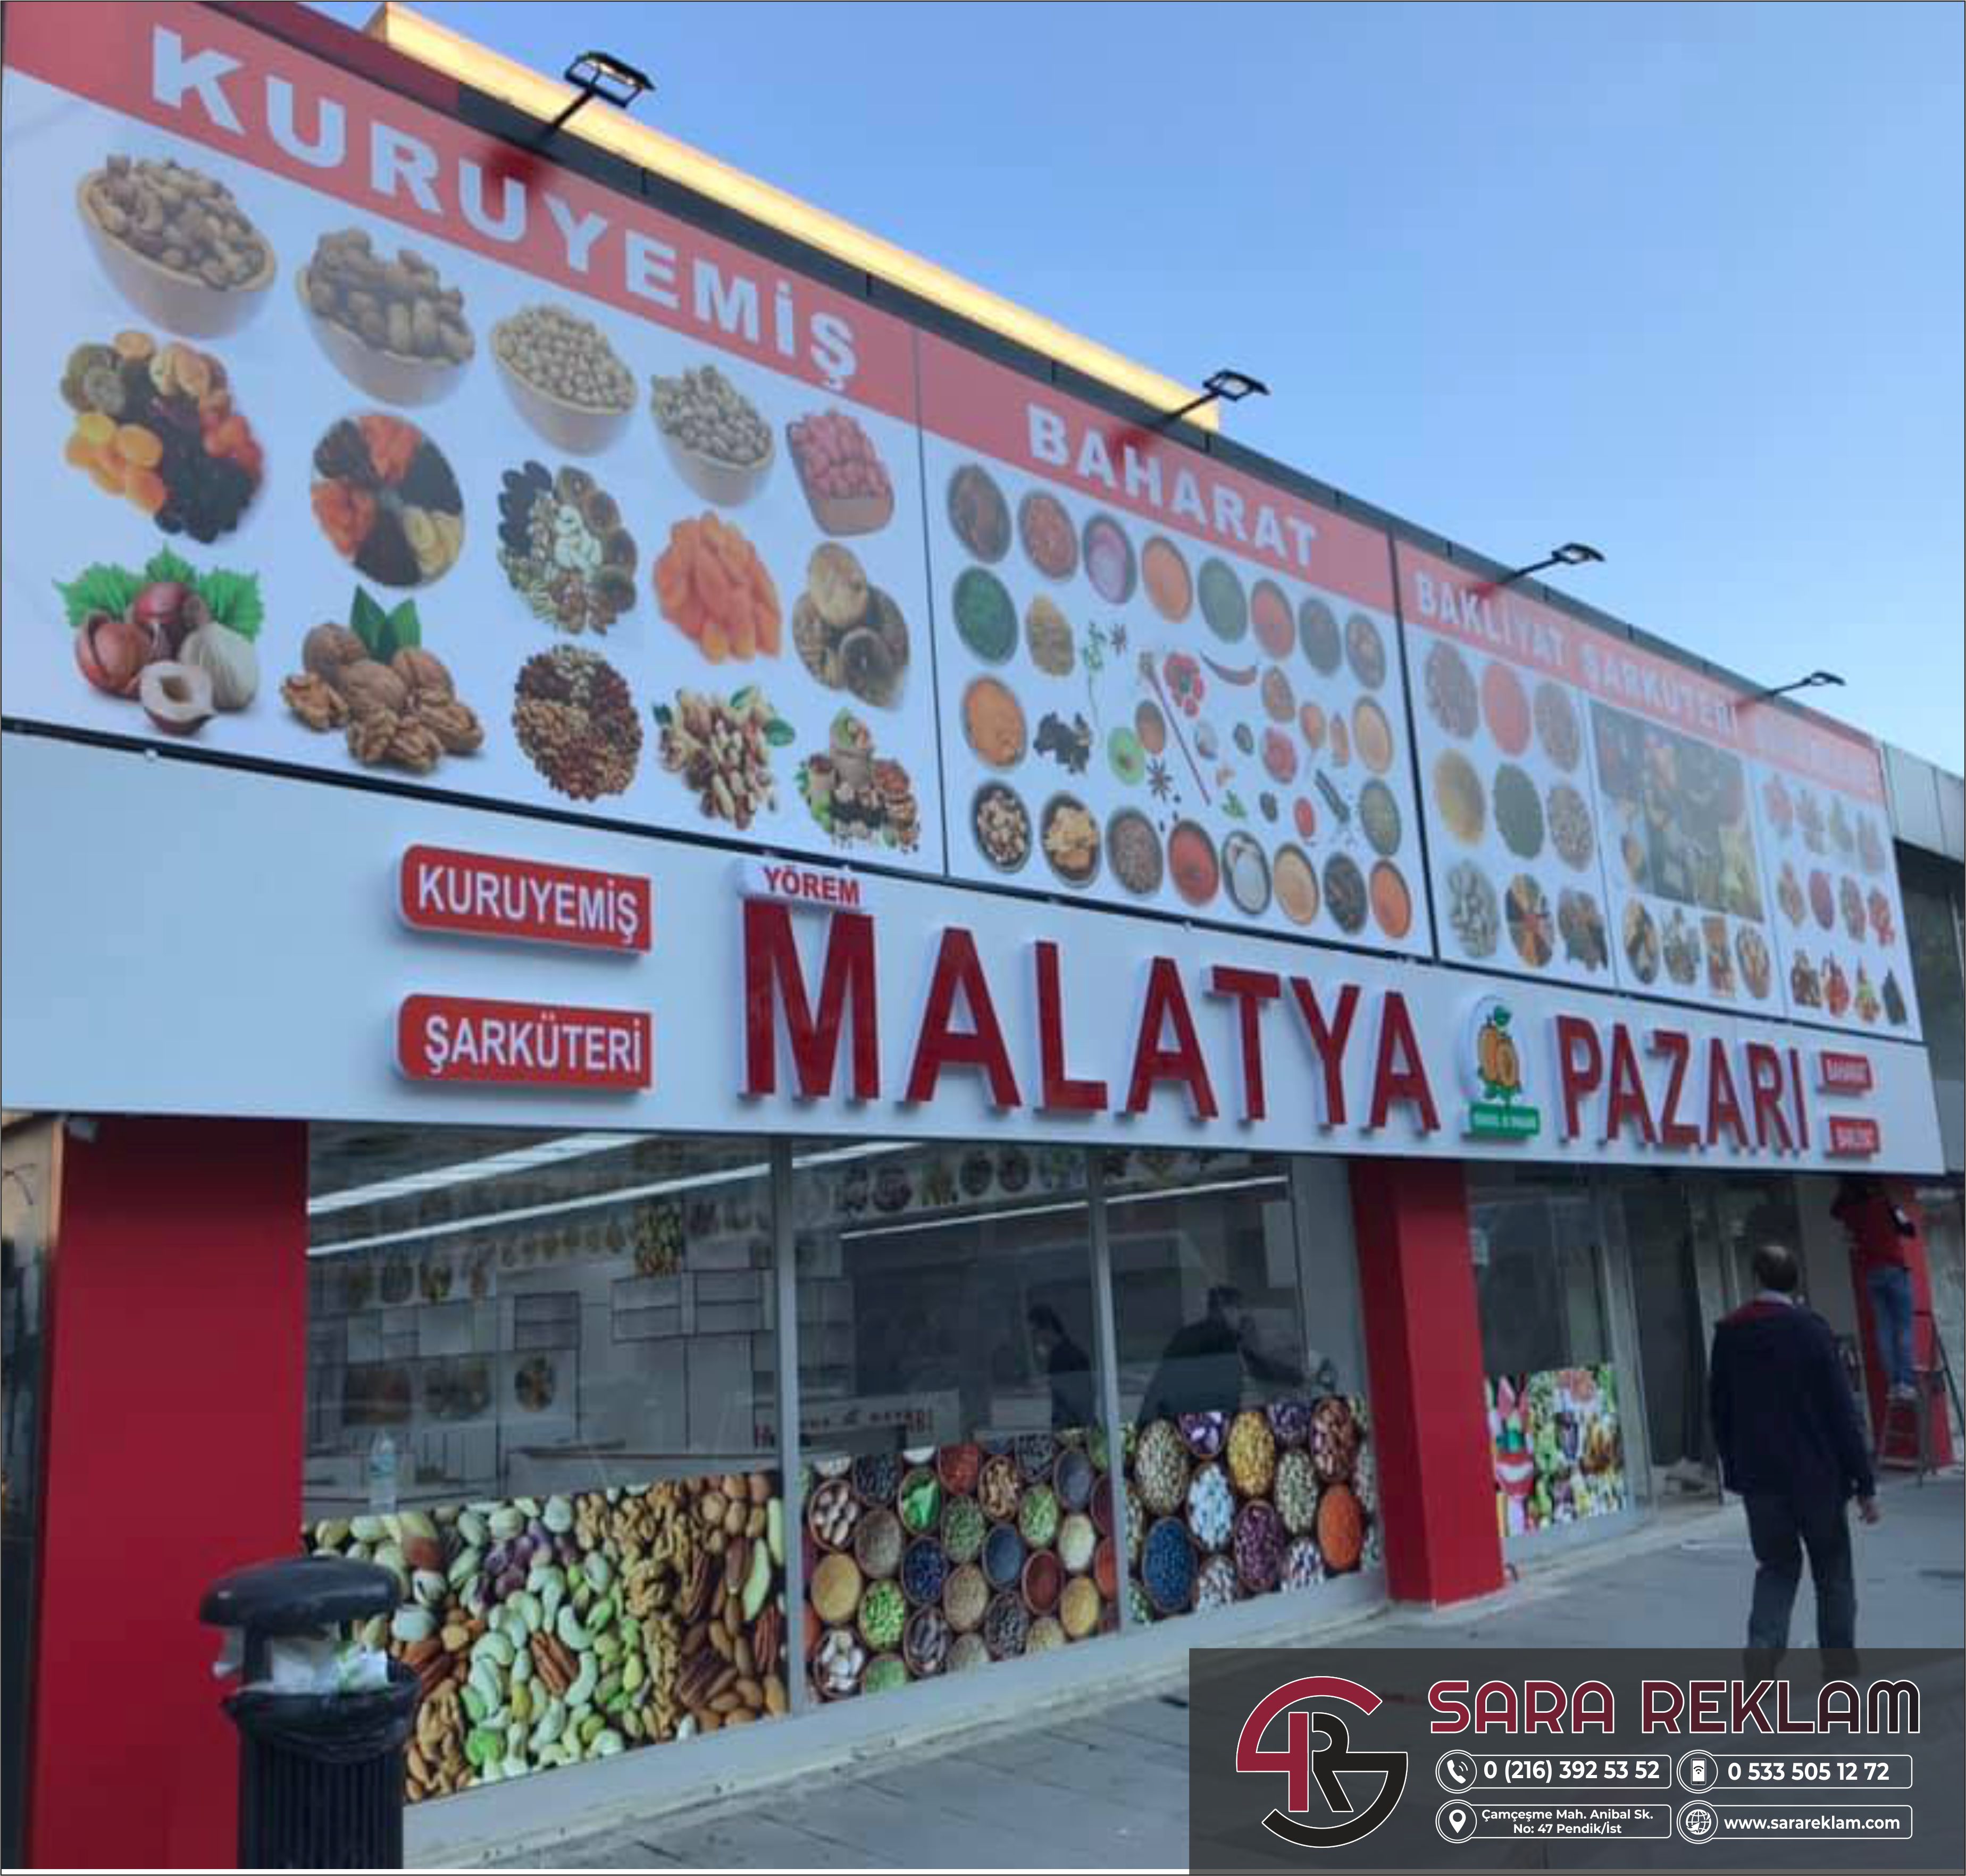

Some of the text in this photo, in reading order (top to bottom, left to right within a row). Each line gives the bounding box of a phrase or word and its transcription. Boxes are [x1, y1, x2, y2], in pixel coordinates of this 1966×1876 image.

[153, 24, 857, 390] KURUYEMİŞ
[1026, 403, 1318, 567] BAHARAT
[419, 865, 638, 943] KURUYEMİŞ
[763, 865, 860, 906] YÖREM
[426, 1012, 641, 1075] ŞARKÜTERİ
[743, 898, 1809, 1150] MALATYA PAZARI
